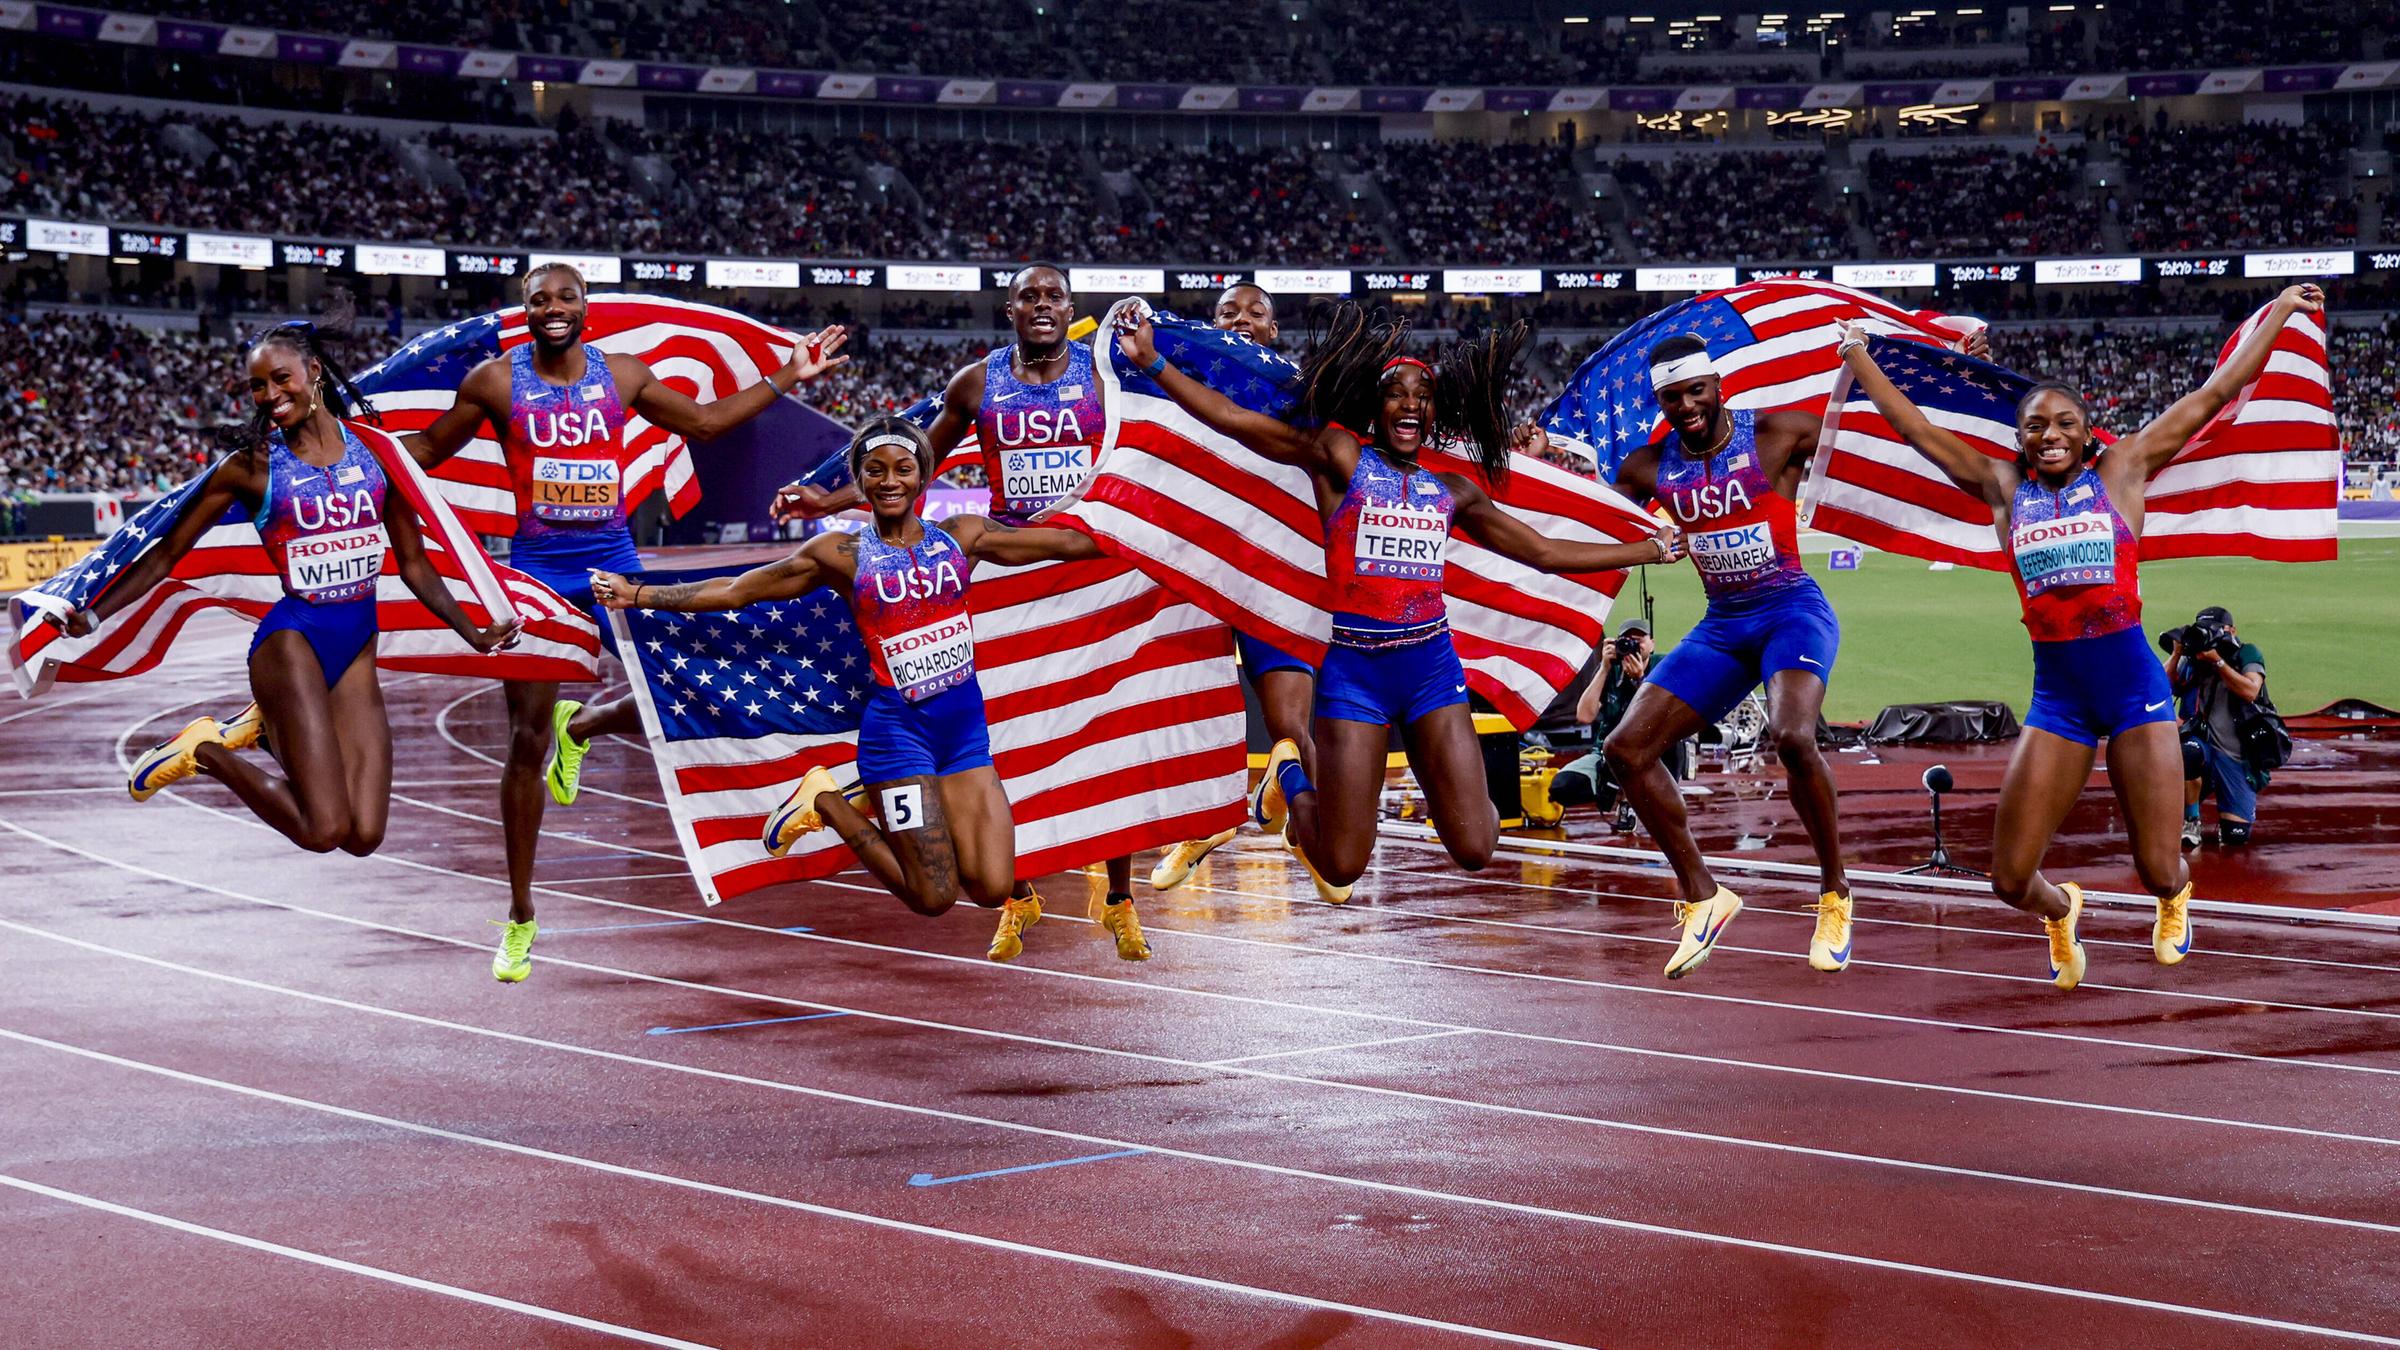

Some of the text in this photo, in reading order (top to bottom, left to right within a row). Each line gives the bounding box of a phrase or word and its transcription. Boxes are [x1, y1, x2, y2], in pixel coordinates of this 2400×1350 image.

[1949, 266, 2020, 282] TOKYO 25
[2156, 259, 2229, 277] TOKYO 25
[2369, 253, 2400, 269] TOKY
[1363, 273, 1430, 290] TOKYO 25
[1554, 273, 1622, 289] TOKYO 25
[528, 408, 610, 448] USA
[997, 408, 1084, 446] USA
[560, 463, 613, 481] TDK
[1024, 450, 1085, 470] TDK
[544, 484, 610, 503] LYLES
[1673, 479, 1752, 522] USA
[292, 489, 378, 530] USA
[1362, 512, 1446, 533] HONDA
[290, 533, 382, 559] HONDA
[1706, 526, 1765, 551] TDK
[2015, 520, 2109, 548] HONDA
[1365, 534, 1442, 561] TERRY
[1697, 546, 1771, 571] BEDNAREK
[298, 553, 379, 585] WHITE
[875, 561, 963, 603] USA
[883, 621, 969, 658] HONDA
[893, 640, 972, 686] RICHARDSON
[894, 793, 912, 825] 5
